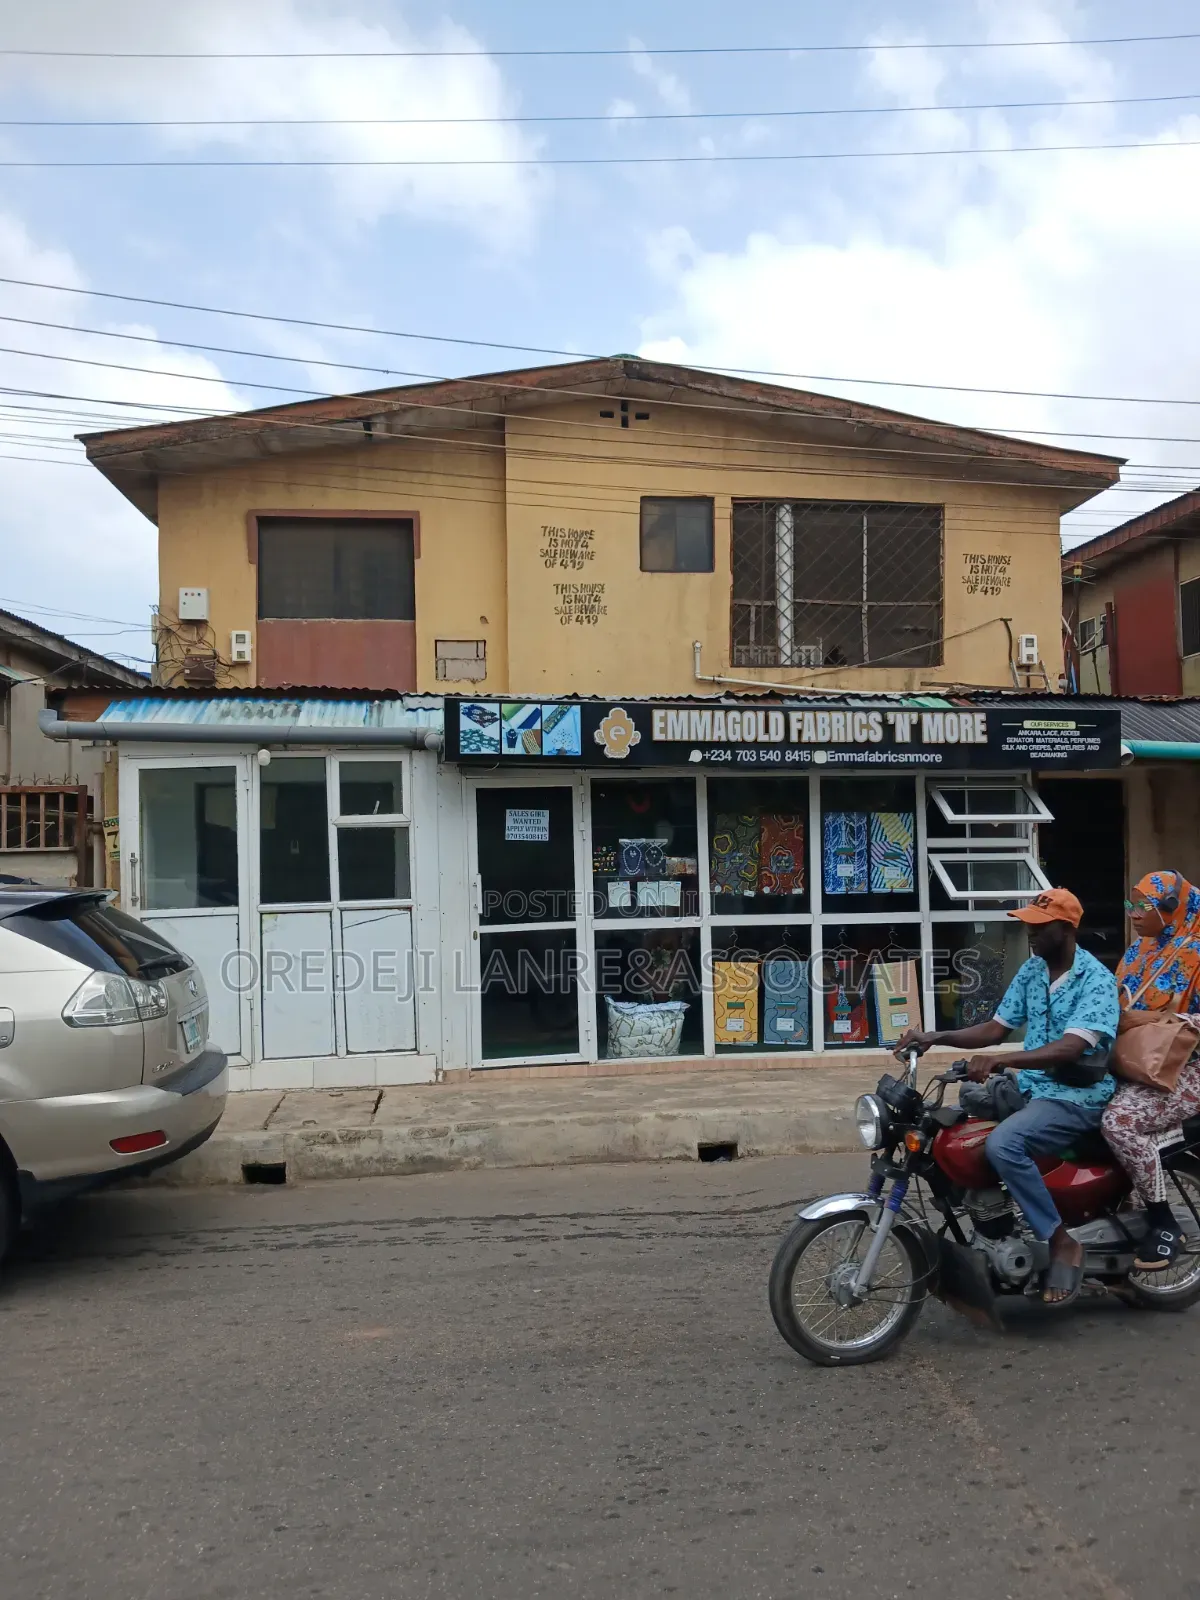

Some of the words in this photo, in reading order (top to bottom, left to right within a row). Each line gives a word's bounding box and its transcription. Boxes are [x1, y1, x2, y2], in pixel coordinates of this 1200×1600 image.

[541, 526, 566, 538] THIS
[568, 528, 595, 540] HOUSE
[548, 538, 559, 548] IS
[581, 540, 589, 550] 4
[540, 549, 558, 559] SALE
[559, 549, 596, 560] BEWARE
[963, 554, 986, 564] THIS
[988, 555, 1012, 565] HOUSE
[545, 559, 557, 569] OF
[559, 559, 584, 570] 419
[970, 565, 980, 574] IS
[999, 566, 1007, 575] 4
[962, 575, 979, 584] SALE
[980, 576, 1012, 587] BEWARE
[553, 584, 579, 595] THIS
[580, 583, 605, 595] HOUSE
[967, 585, 978, 594] OF
[980, 586, 1001, 595] 419
[562, 595, 573, 605] IS
[593, 595, 602, 604] 4
[554, 606, 573, 616] SALE
[574, 604, 608, 615] BEWARE
[560, 615, 573, 626] OF
[575, 615, 598, 626] 419
[652, 709, 785, 743] EMMAGOLD
[788, 711, 883, 743] FABRICS
[922, 712, 988, 744] MORE
[703, 750, 732, 761] +234
[735, 750, 756, 761] 703
[760, 750, 781, 761] 540
[785, 750, 811, 762] 8415
[827, 750, 943, 763] Emmafabricsnmore
